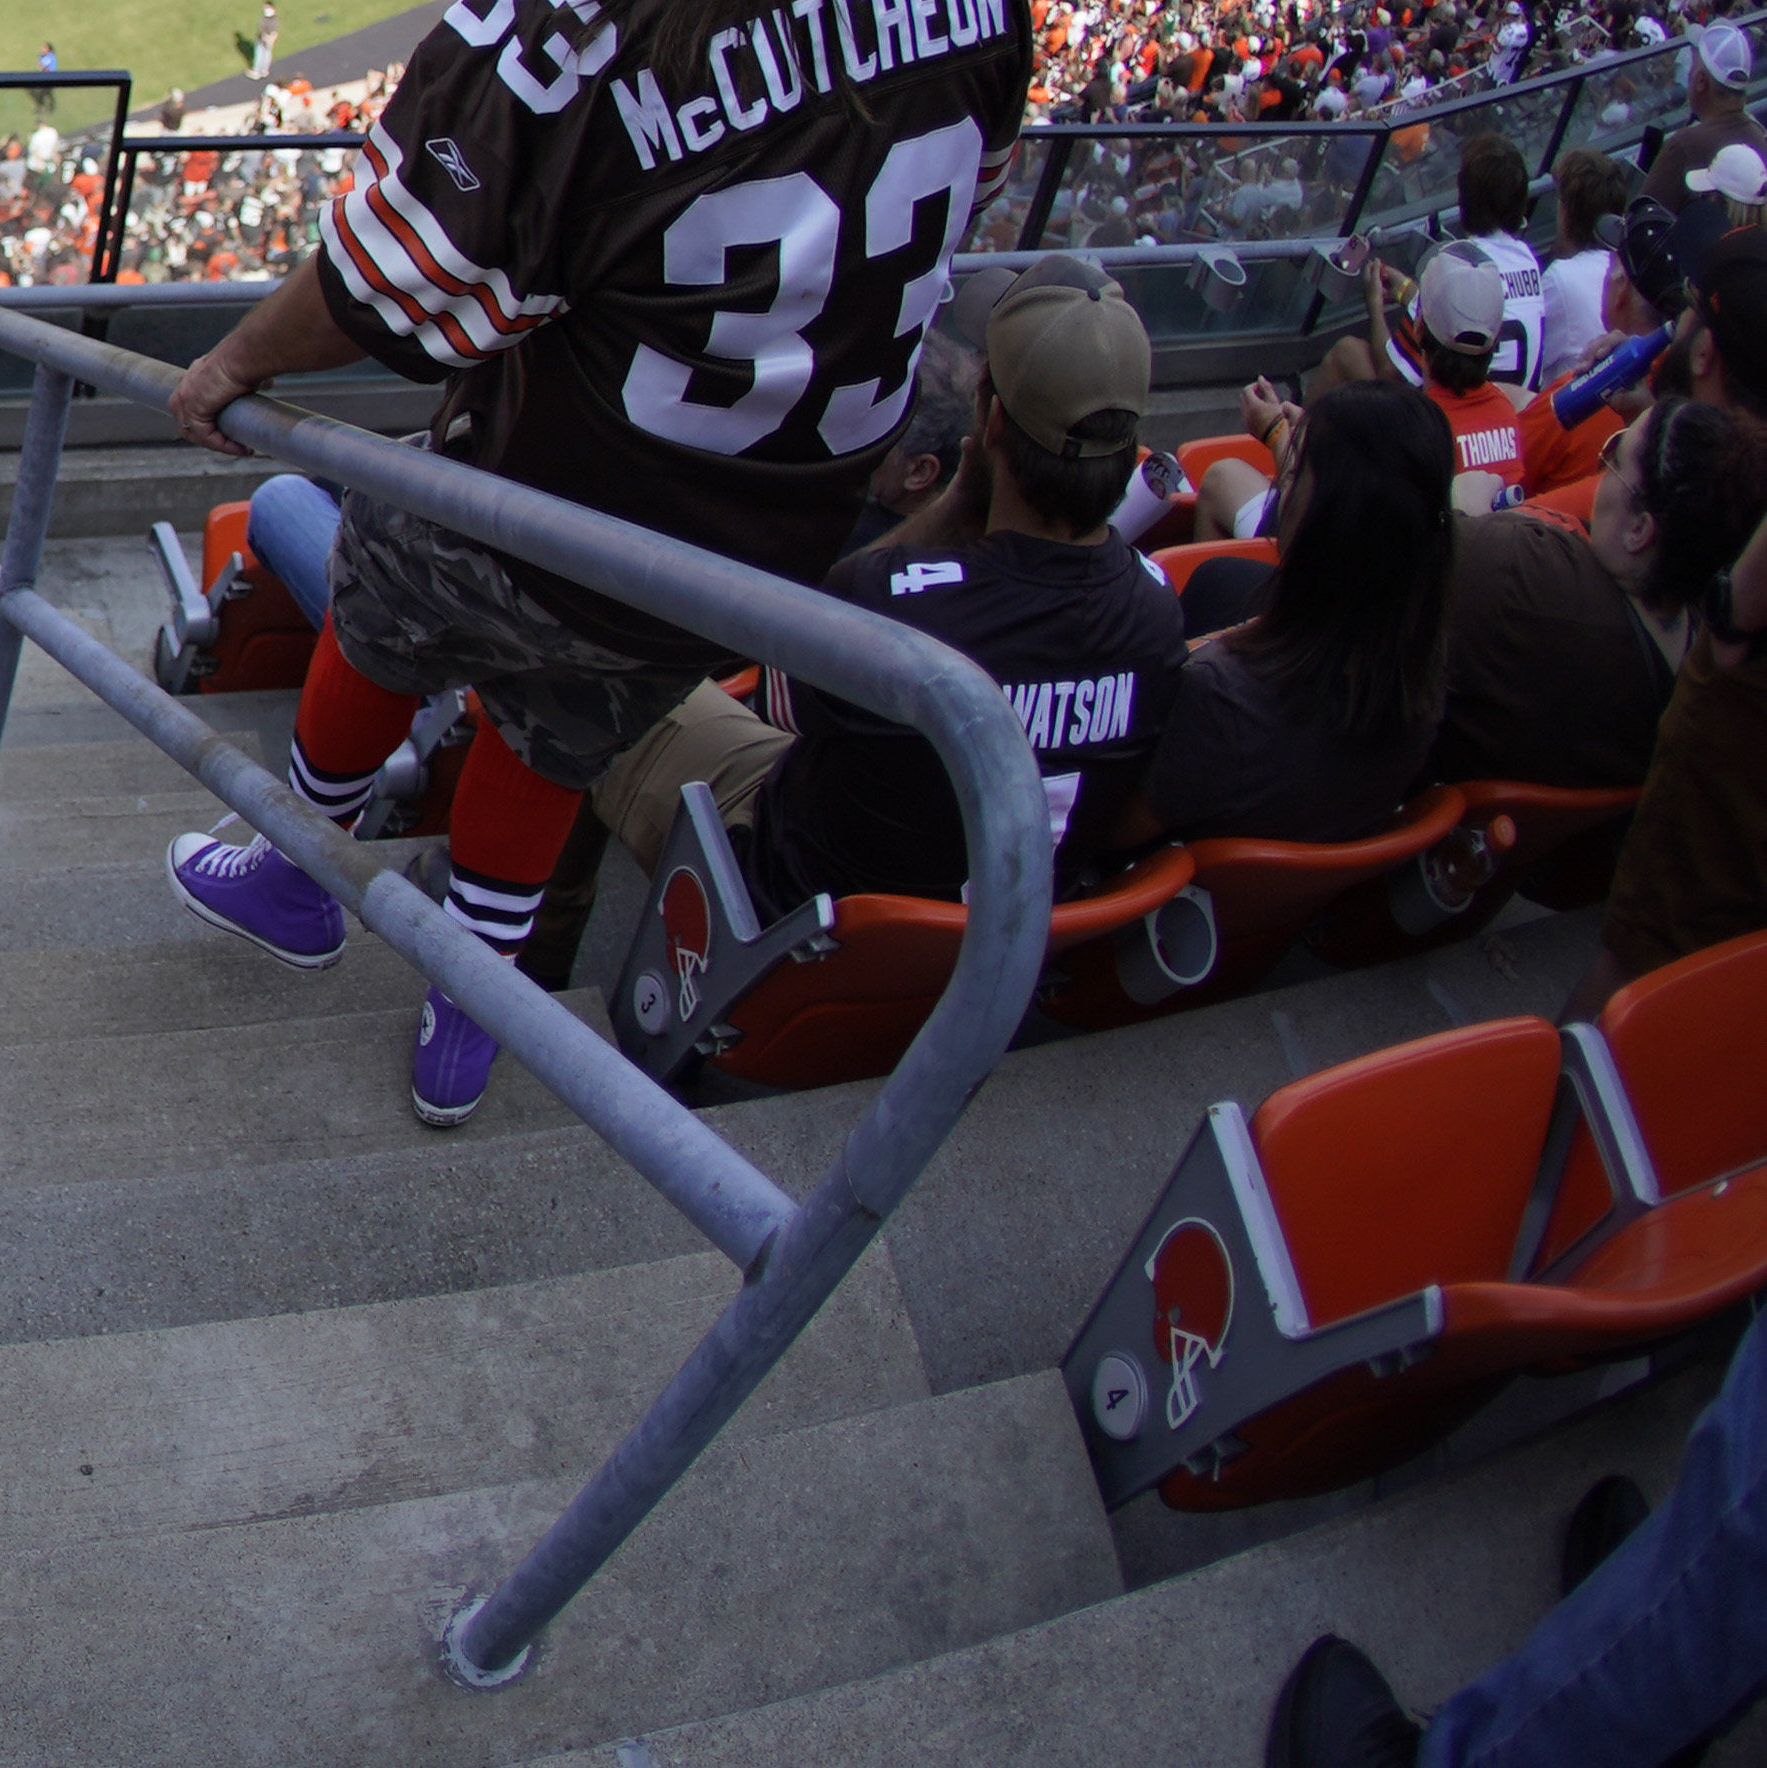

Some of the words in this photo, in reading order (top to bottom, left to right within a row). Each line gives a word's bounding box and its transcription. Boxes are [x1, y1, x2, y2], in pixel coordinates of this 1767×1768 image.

[621, 115, 983, 457] 33
[1499, 268, 1541, 301] CHUBB
[1456, 426, 1517, 469] THOMAS
[890, 560, 963, 596] 4
[1003, 672, 1134, 750] WATSON
[640, 993, 657, 1014] 3
[1105, 1388, 1130, 1412] 4
